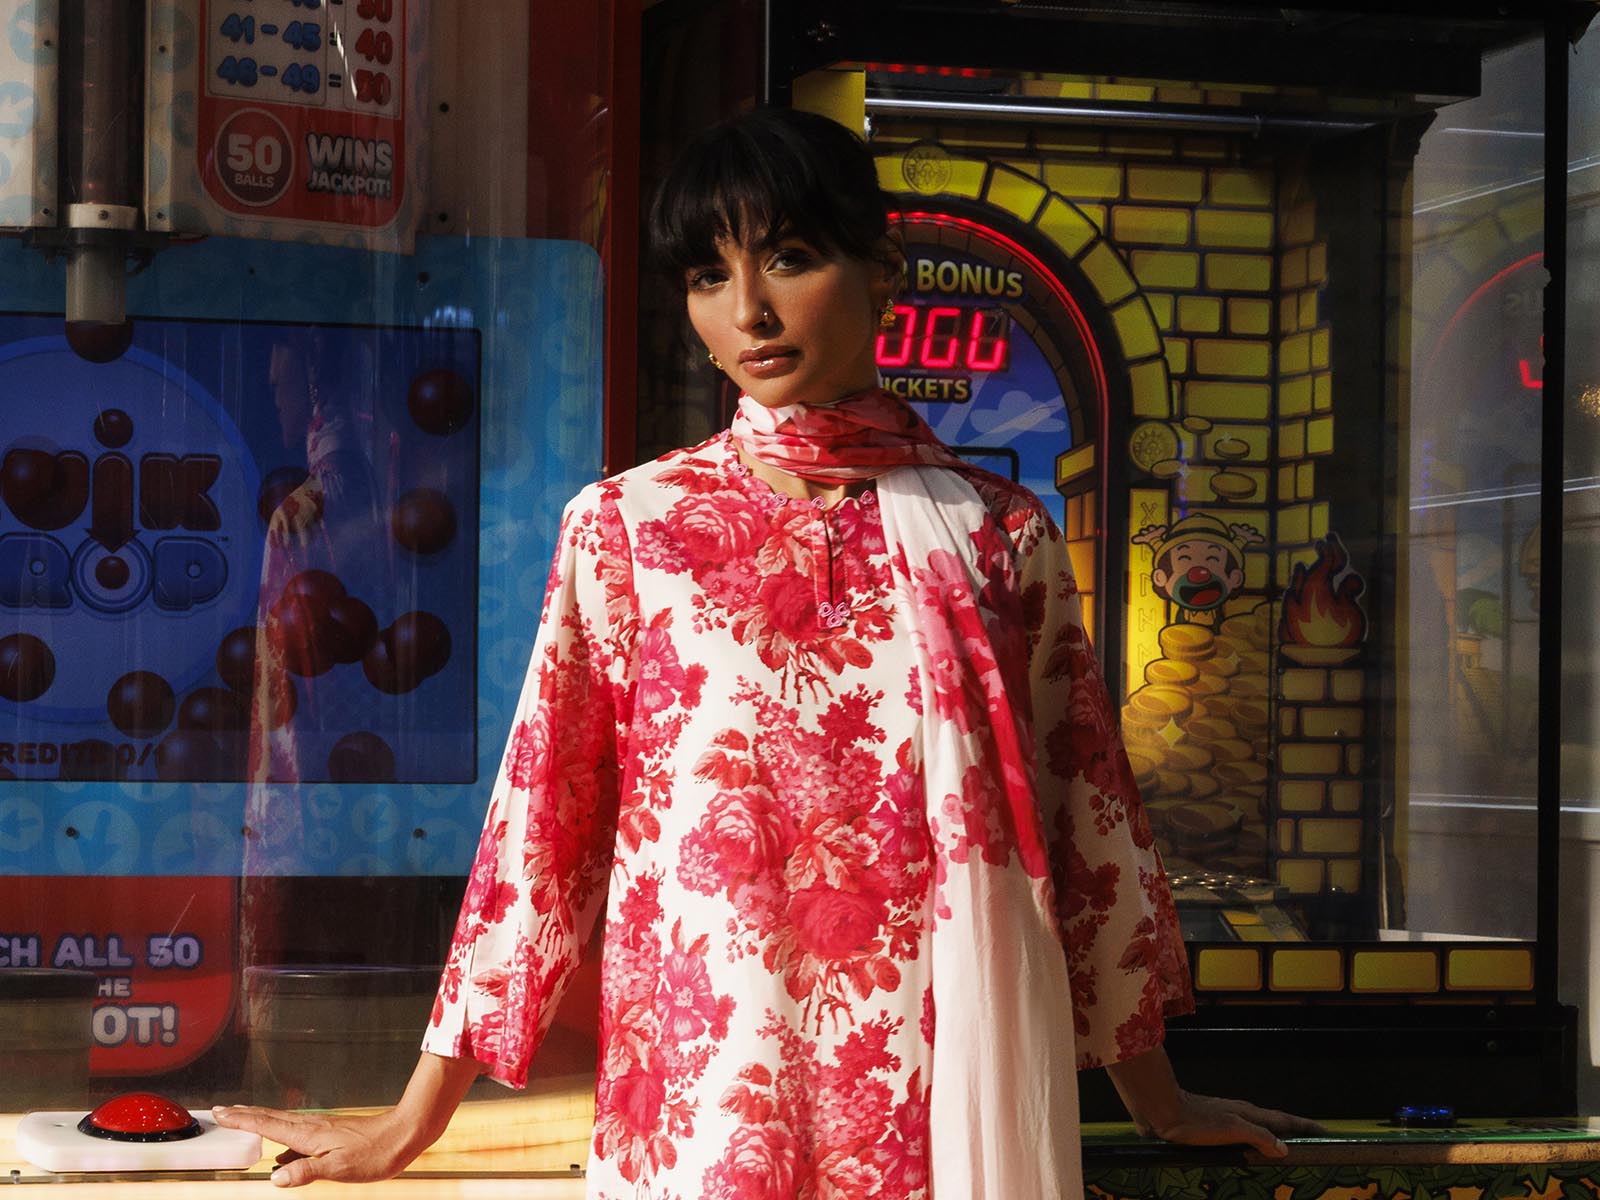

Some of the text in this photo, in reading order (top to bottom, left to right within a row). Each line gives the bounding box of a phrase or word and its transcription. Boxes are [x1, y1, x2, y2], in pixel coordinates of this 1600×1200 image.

[355, 28, 392, 65] 40
[227, 134, 282, 174] 50
[306, 133, 393, 176] WINS
[234, 175, 275, 188] BALLS
[308, 171, 392, 197] JACKPOT!
[916, 258, 1023, 298] BONUS
[883, 377, 969, 399] ICKETS
[0, 532, 228, 614] ROP
[54, 937, 133, 967] ALL
[149, 937, 200, 967] 50
[98, 978, 131, 998] HE
[92, 1006, 176, 1044] OT!
